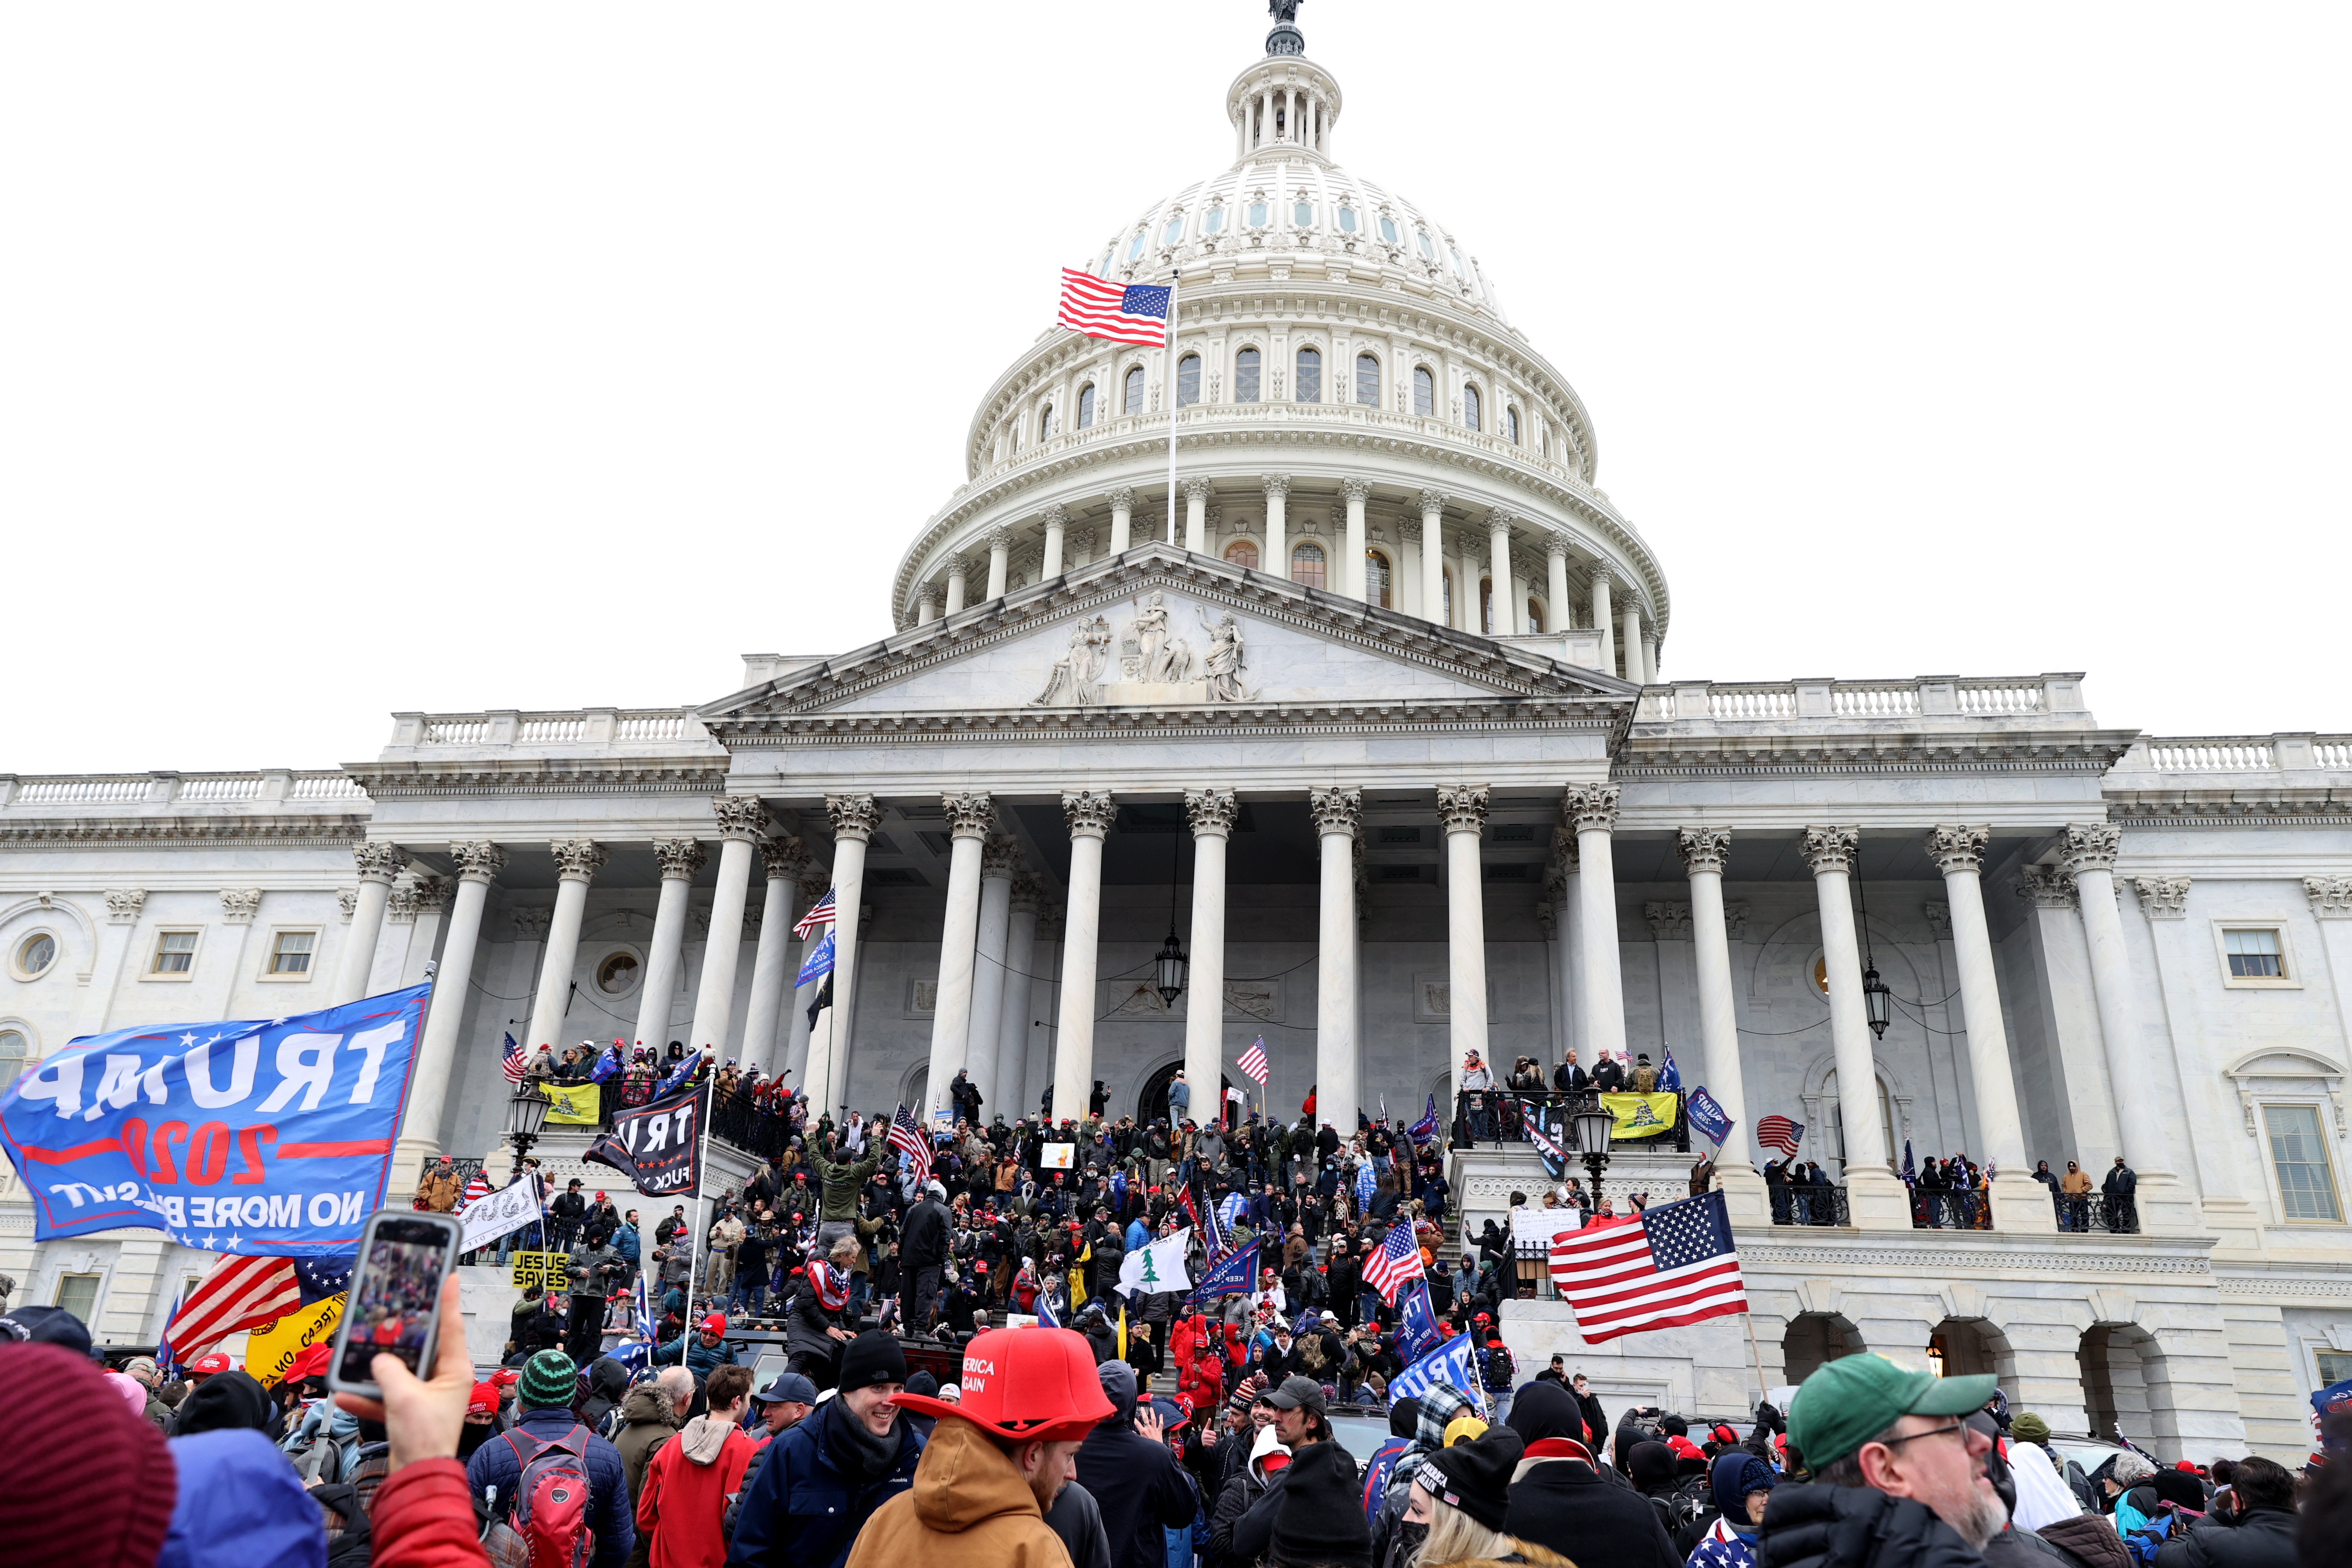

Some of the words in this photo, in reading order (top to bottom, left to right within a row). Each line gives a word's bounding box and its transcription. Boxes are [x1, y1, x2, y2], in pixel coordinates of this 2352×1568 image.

[515, 1255, 567, 1271] JESUS
[514, 1271, 566, 1287] SAVES
[963, 1357, 995, 1376] MERICA
[1230, 1395, 1248, 1409] MAKE
[1416, 1471, 1437, 1494] AGAIN
